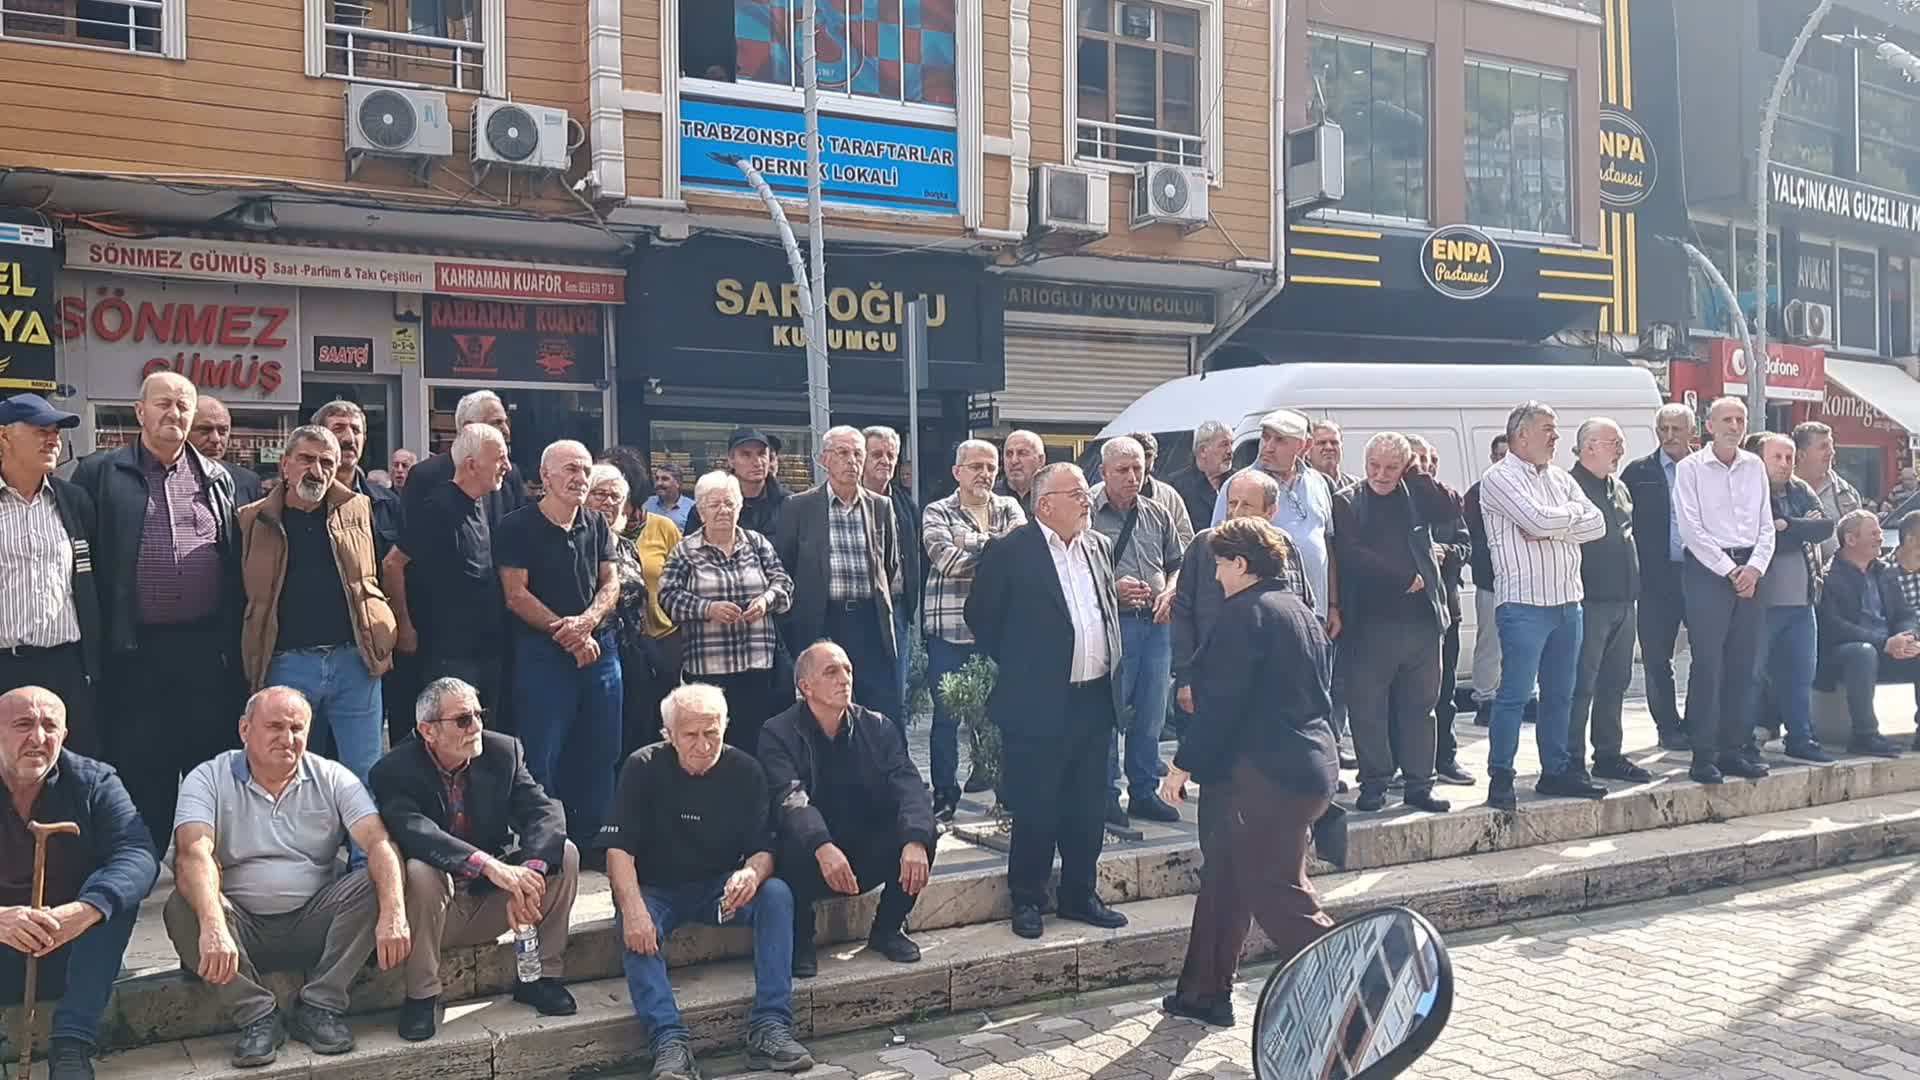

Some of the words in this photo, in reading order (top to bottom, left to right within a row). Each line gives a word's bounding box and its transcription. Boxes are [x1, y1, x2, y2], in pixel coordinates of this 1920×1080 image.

[829, 136, 953, 165] TARAFTARLAR
[751, 156, 827, 179] DERNK
[834, 165, 897, 186] LOKALİ
[1772, 171, 1849, 216] YALÇINKAYA
[89, 243, 182, 269] SÖNMEZ
[190, 252, 266, 279] GÜMÜŞ
[273, 262, 297, 276] Saat
[355, 267, 377, 281] Takı
[380, 270, 422, 285] Çeşitleri
[1432, 239, 1492, 264] ENPA
[440, 267, 511, 290] KAHRAMAN
[1434, 264, 1489, 283] Pastanesi
[715, 278, 946, 328] SAROĞU
[1004, 287, 1082, 307] ARIOGLU
[54, 288, 289, 348] SÖNMEZ
[772, 325, 897, 352] KUUMCU
[1753, 355, 1800, 377] dafone
